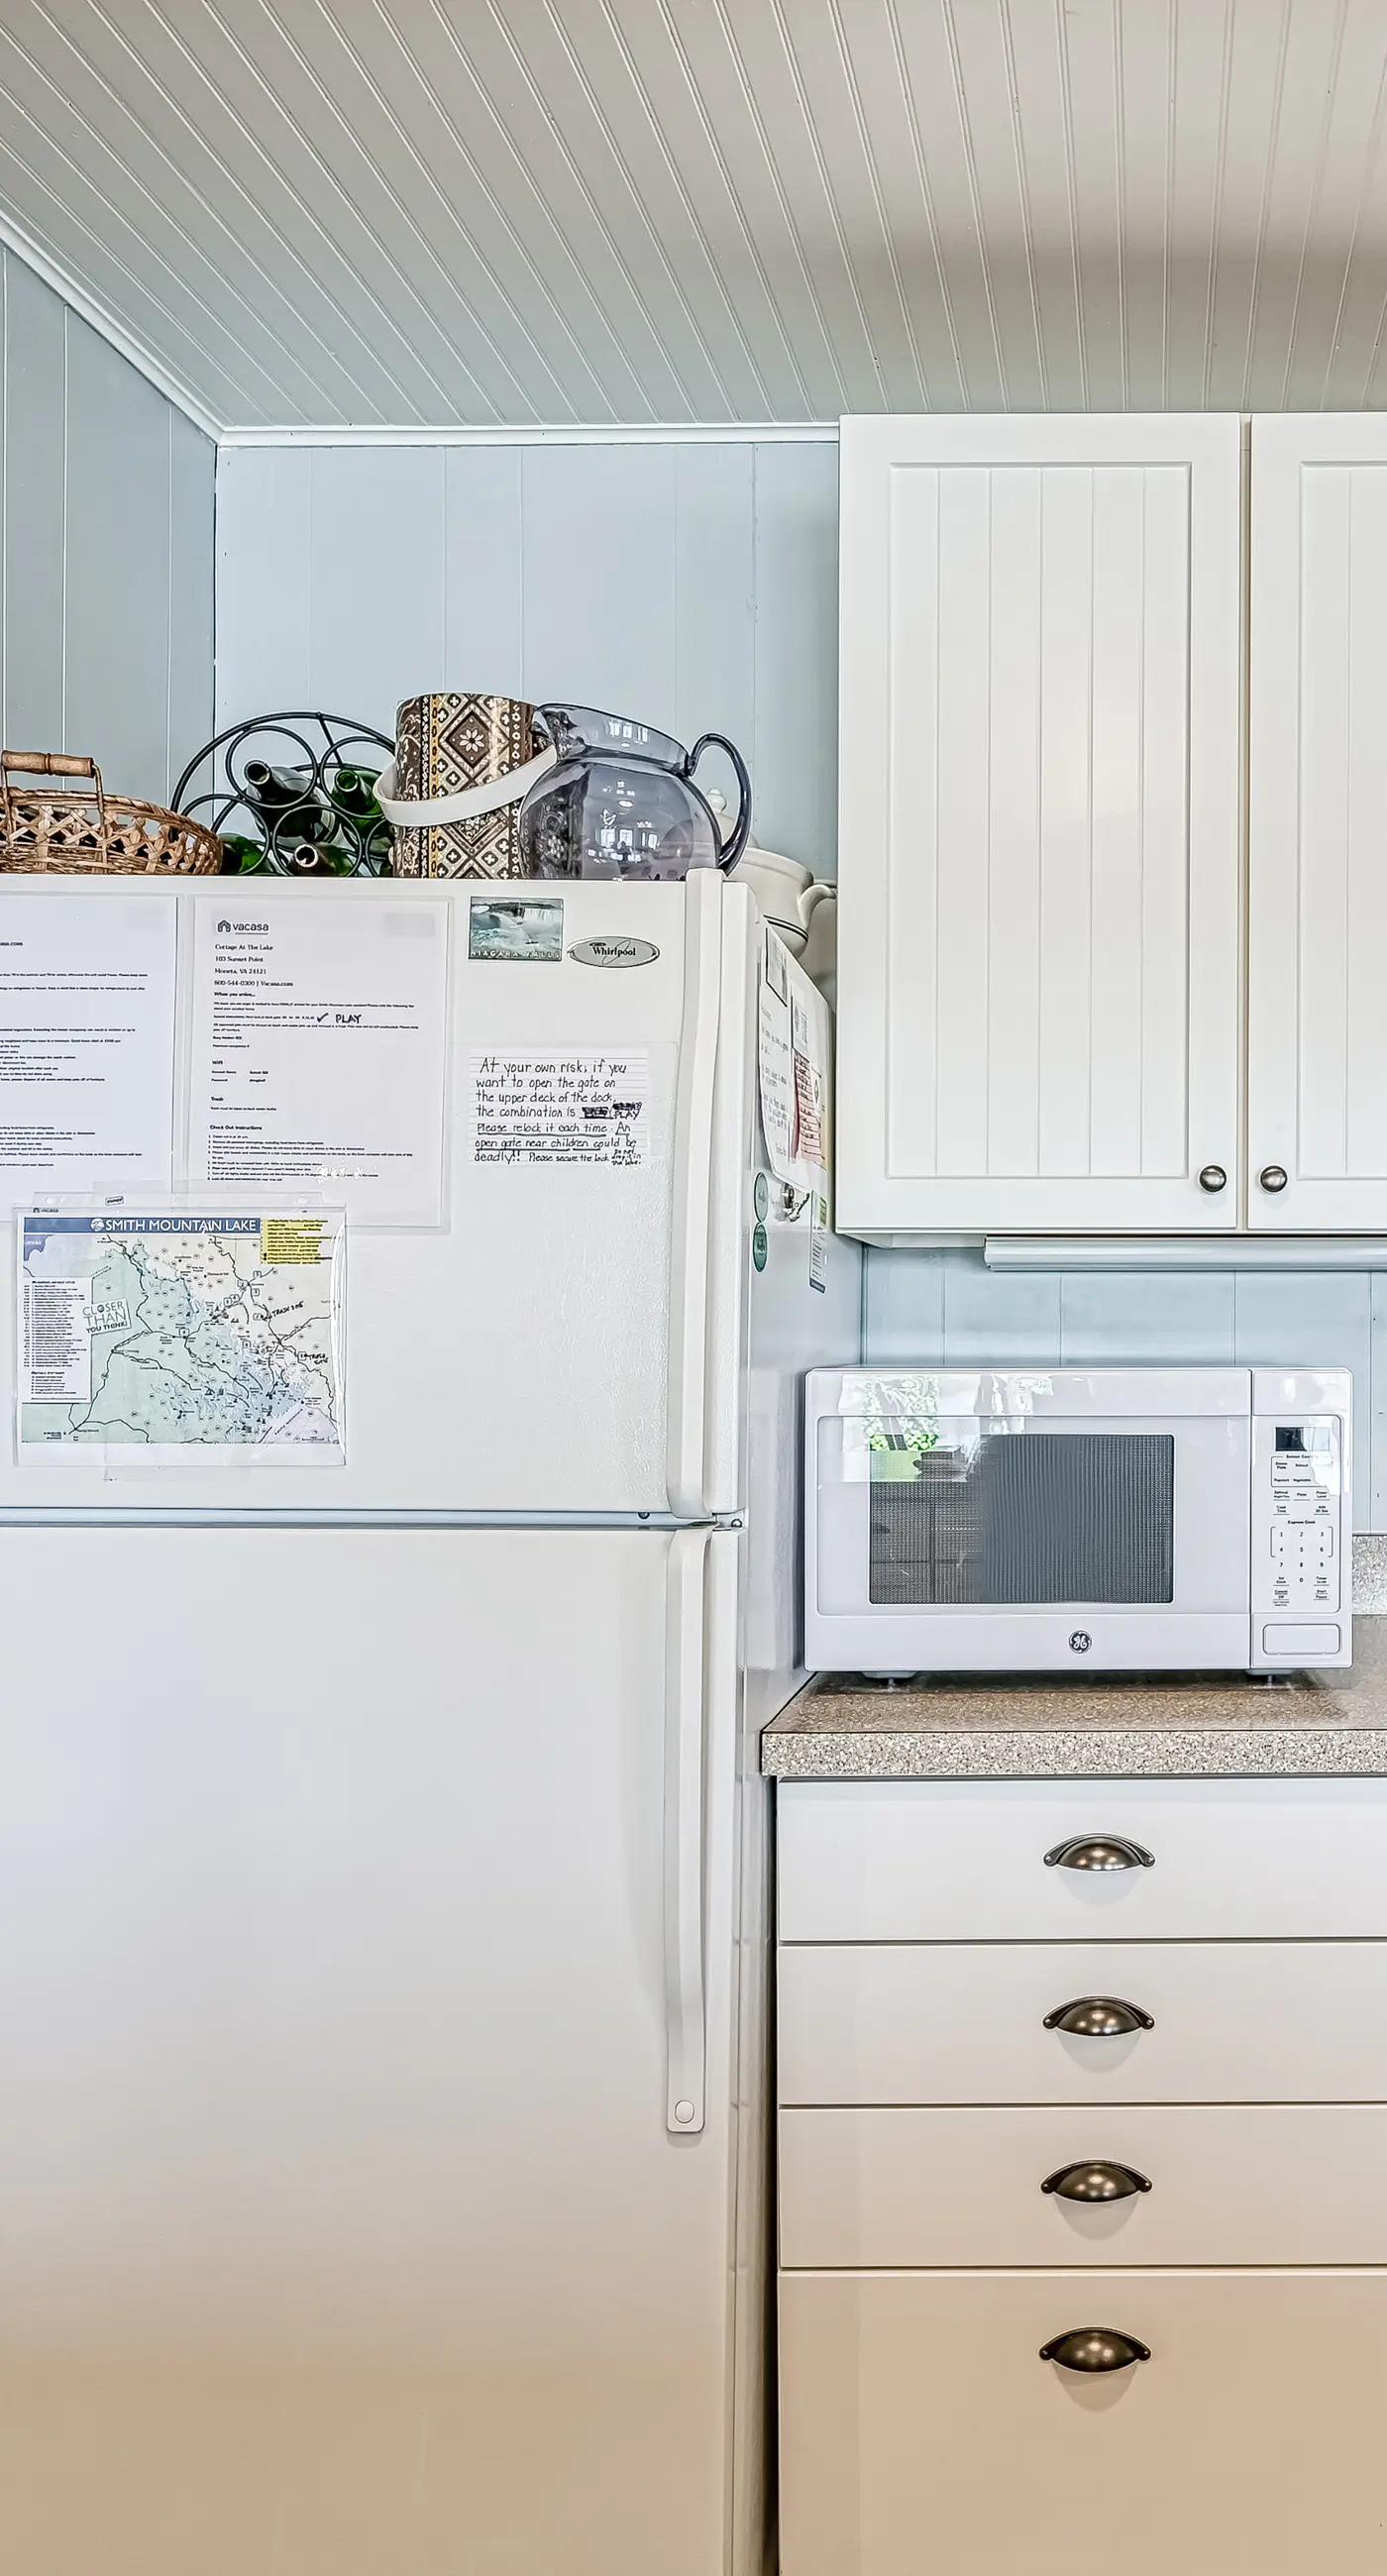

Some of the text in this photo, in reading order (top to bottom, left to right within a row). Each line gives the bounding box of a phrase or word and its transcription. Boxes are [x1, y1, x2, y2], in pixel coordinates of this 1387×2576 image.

[232, 922, 269, 931] vacasa
[593, 946, 636, 957] Whirlpool
[335, 1014, 363, 1024] PLAY
[480, 1056, 500, 1074] At
[503, 1063, 532, 1078] your
[534, 1064, 557, 1073] own
[592, 1058, 606, 1073] if
[608, 1064, 627, 1077] you
[476, 1073, 616, 1093] want to open the gate on
[476, 1089, 494, 1103] the
[498, 1093, 528, 1106] upper
[529, 1091, 556, 1103] deck
[558, 1091, 571, 1103] of
[571, 1091, 588, 1103] the
[476, 1104, 494, 1118] the
[499, 1104, 563, 1118] combination
[567, 1106, 577, 1118] is
[613, 1110, 641, 1121] PLAY
[477, 1123, 507, 1132] Please
[512, 1123, 542, 1133] relock
[545, 1123, 555, 1132] it
[558, 1123, 581, 1132] each
[615, 1121, 631, 1132] An
[475, 1139, 498, 1149] open
[500, 1136, 522, 1149] gate
[550, 1138, 589, 1147] children
[592, 1136, 620, 1149] could
[474, 1150, 521, 1165] deadly!!
[528, 1151, 554, 1162] Please
[579, 1153, 593, 1162] the
[105, 1220, 257, 1233] SMITH MOUNTAIN LAKE
[82, 1300, 125, 1317] CLOSER
[83, 1309, 127, 1328] THAN
